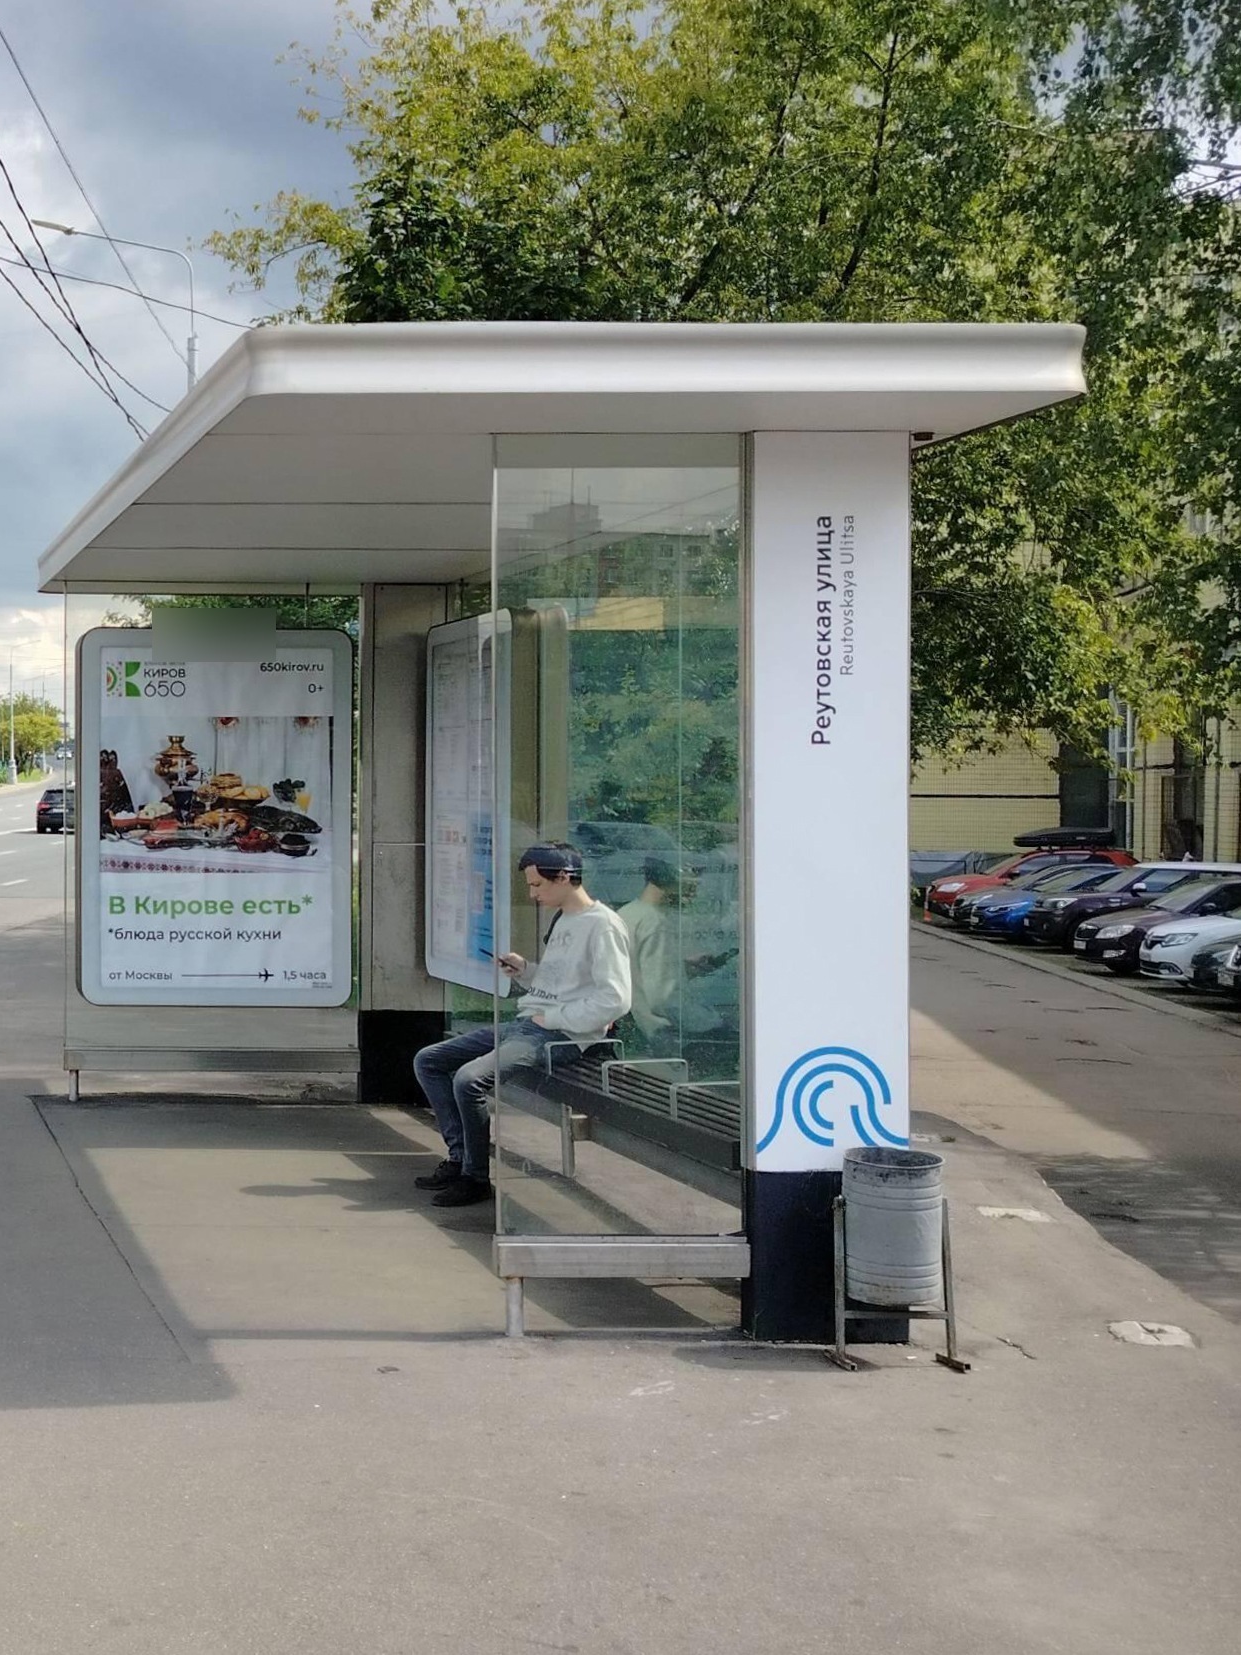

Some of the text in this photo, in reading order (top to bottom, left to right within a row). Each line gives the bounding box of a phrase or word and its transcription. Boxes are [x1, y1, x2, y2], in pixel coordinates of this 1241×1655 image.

[839, 515, 857, 676] Reutovskaya Ulitsa
[811, 516, 836, 745] Реутовская улица
[143, 668, 186, 678] КИРОВ
[260, 661, 324, 673] 650kirov.ru
[144, 680, 186, 697] 650
[307, 683, 325, 694] 0+
[109, 896, 126, 915] В
[135, 896, 234, 919] Кирове
[169, 928, 233, 942] русской
[236, 931, 282, 942] кухни
[109, 971, 327, 981] от Москвы 1,5 часа
